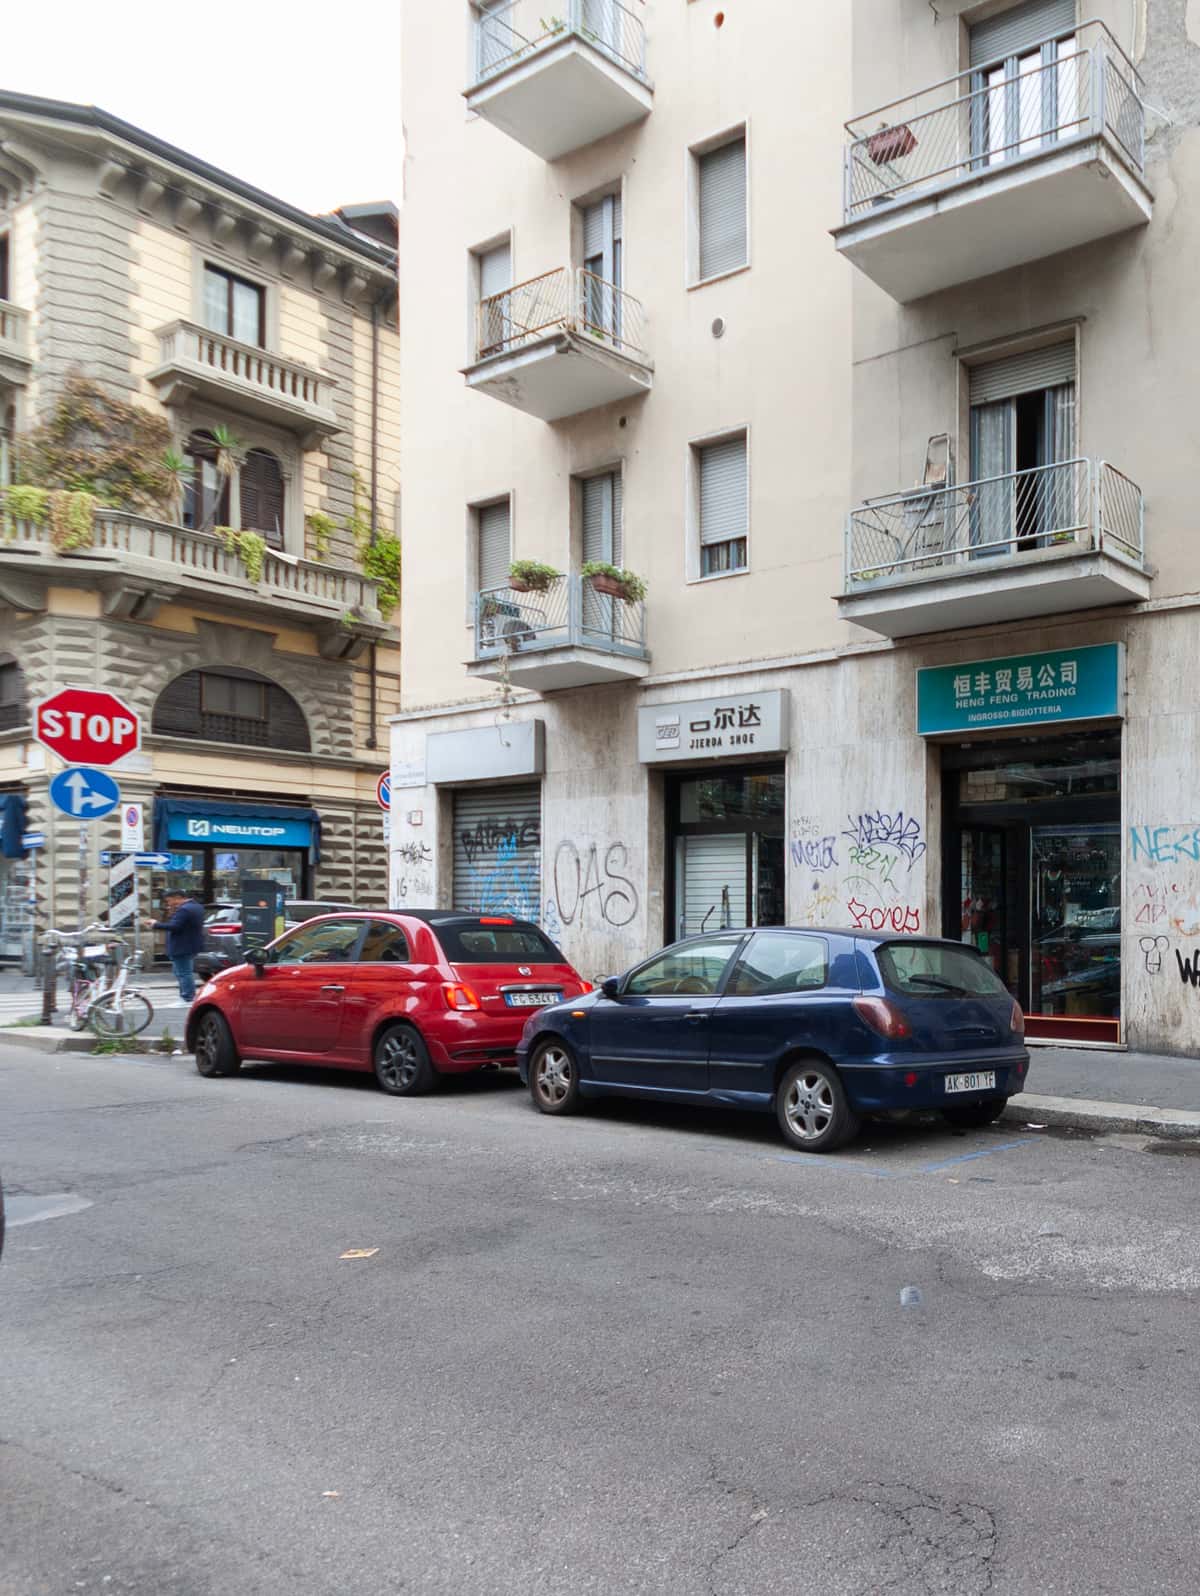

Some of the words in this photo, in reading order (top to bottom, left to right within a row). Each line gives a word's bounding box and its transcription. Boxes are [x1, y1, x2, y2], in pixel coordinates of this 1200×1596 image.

[954, 661, 1078, 699] 恒丰贸易公司
[955, 697, 985, 709] HENG
[990, 693, 1019, 705] FENG
[1026, 686, 1077, 701] TRADING
[968, 710, 1009, 722] INGROSSO
[1011, 705, 1062, 719] BIGIOTTERIA
[41, 709, 134, 745] STOP
[689, 737, 722, 749] JIERDA
[729, 733, 755, 745] SHOE
[212, 824, 286, 837] NEWTOP
